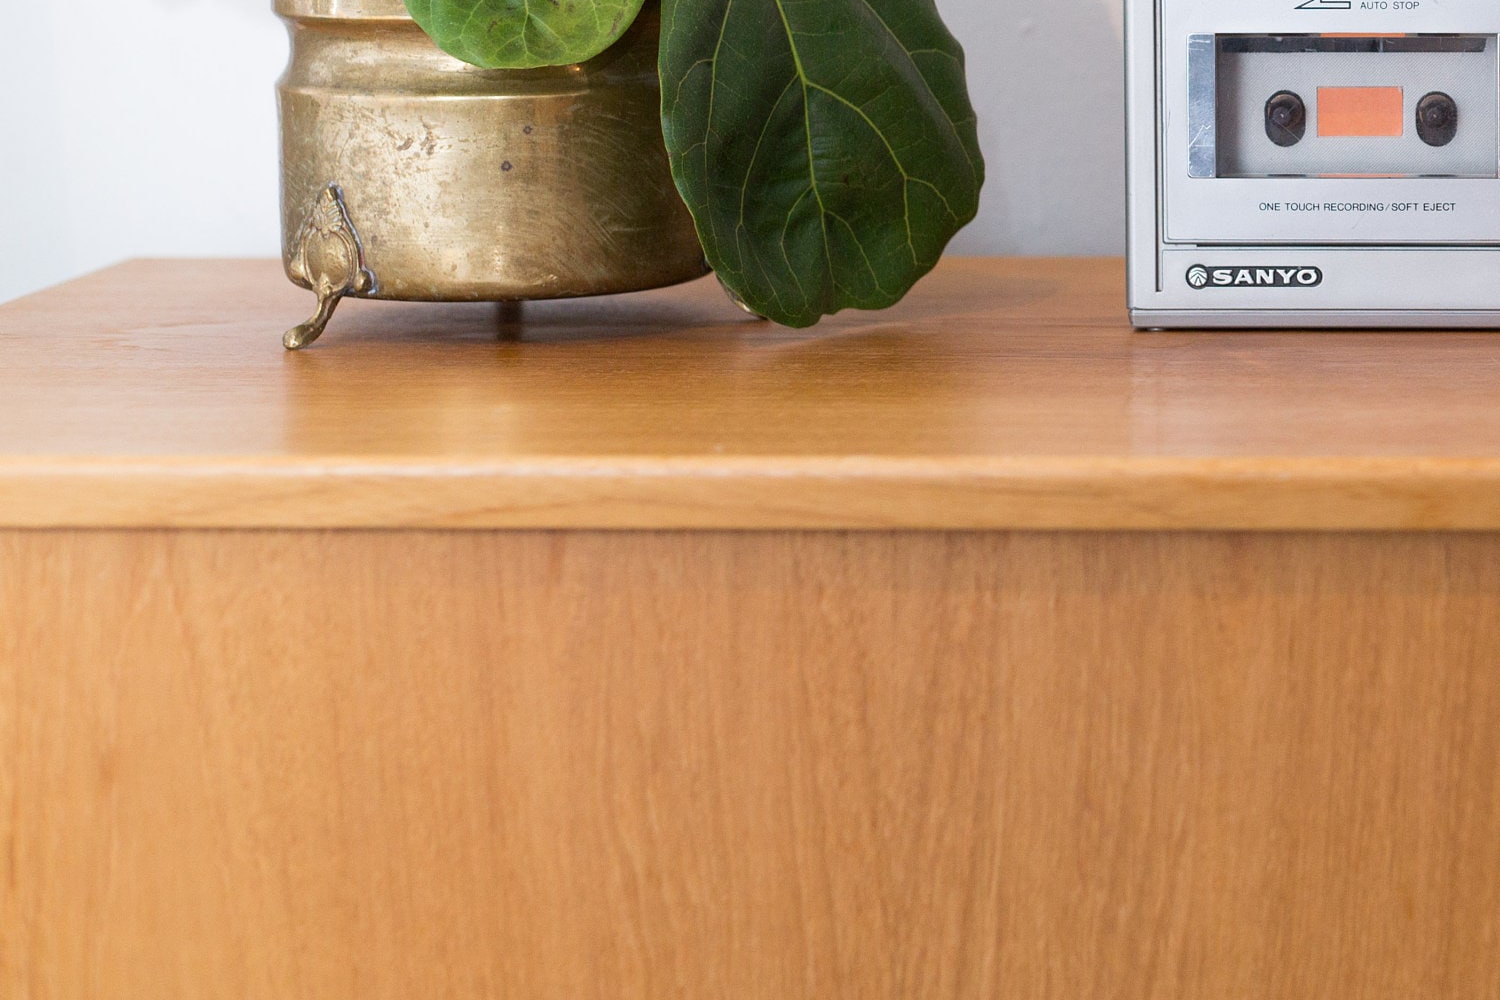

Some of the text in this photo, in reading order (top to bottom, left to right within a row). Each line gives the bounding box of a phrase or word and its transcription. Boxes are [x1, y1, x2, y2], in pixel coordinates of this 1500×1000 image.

[1360, 1, 1420, 10] AUTO STOP
[1258, 202, 1281, 212] ONE
[1285, 202, 1320, 212] TOUCH
[1423, 202, 1457, 212] EJECT
[1212, 268, 1318, 285] SANYO
